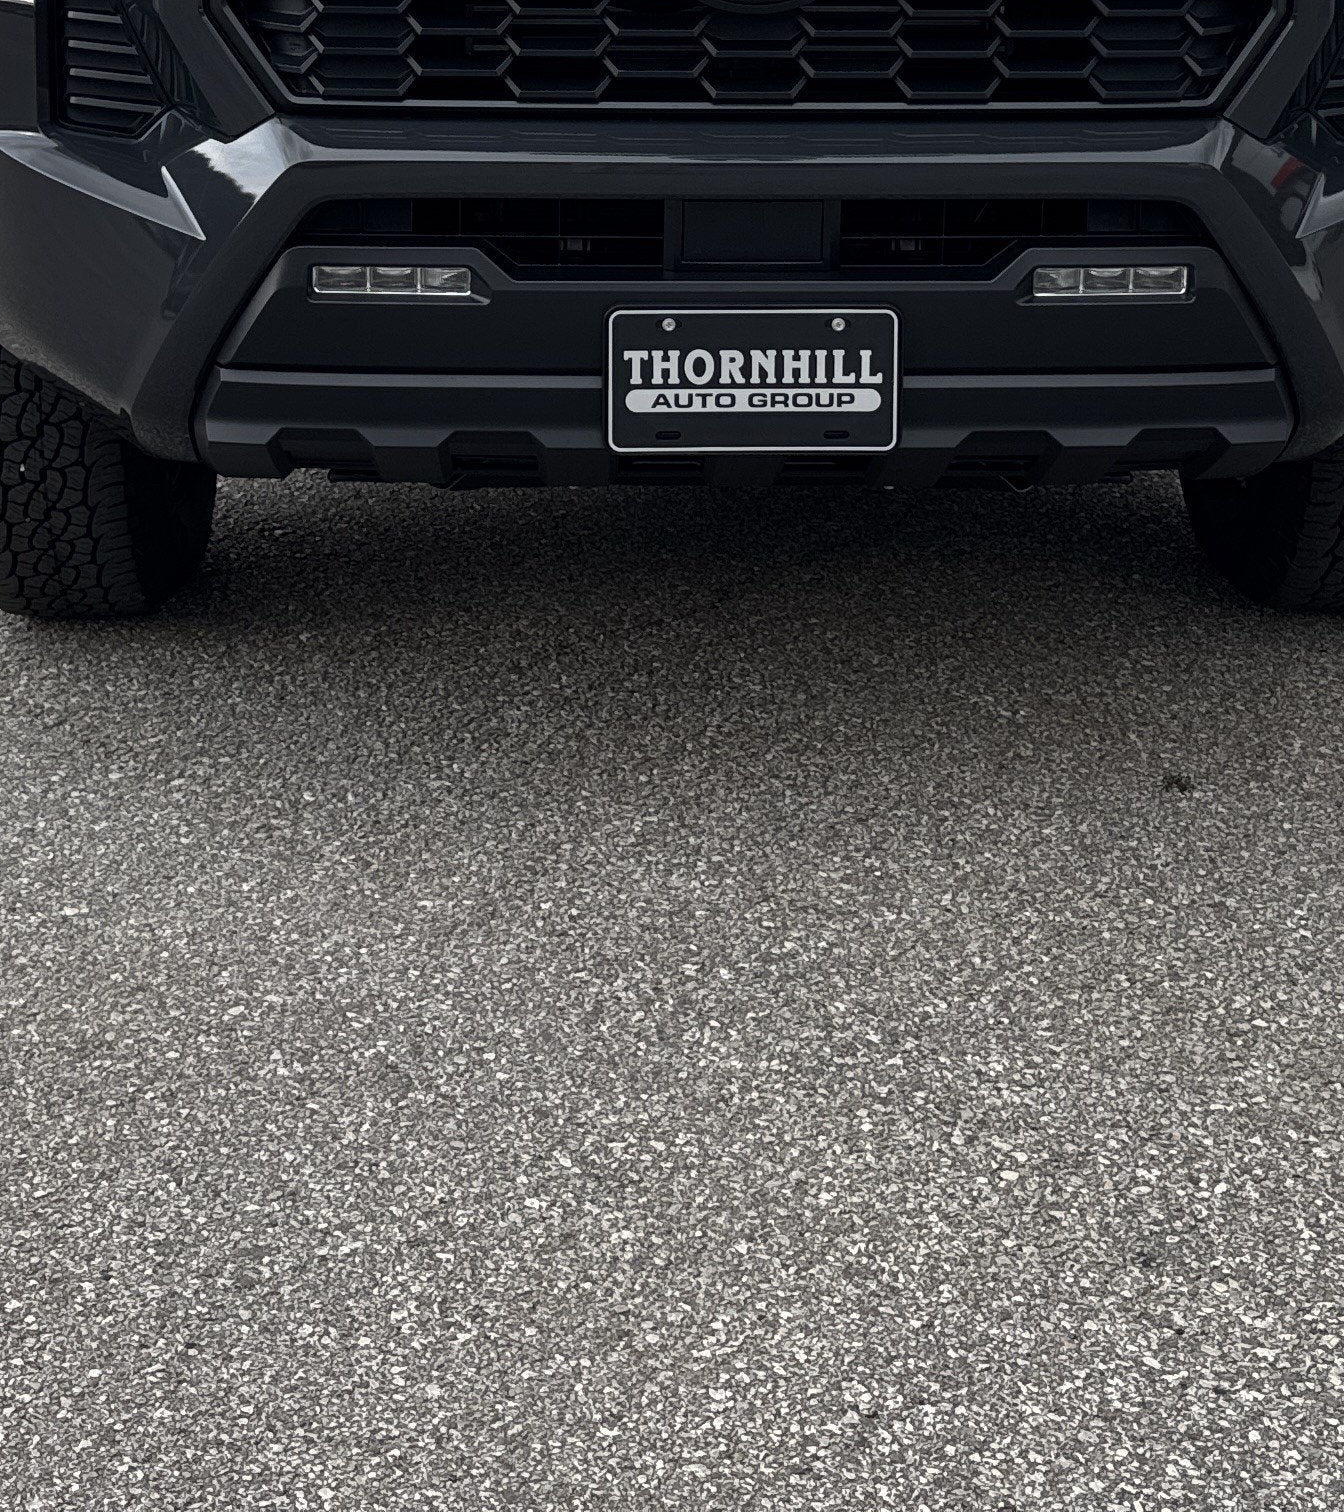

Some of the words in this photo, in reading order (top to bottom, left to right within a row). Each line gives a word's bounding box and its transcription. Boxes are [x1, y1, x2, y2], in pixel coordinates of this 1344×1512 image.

[623, 348, 883, 385] THORNHILL
[651, 392, 737, 409] AUTO
[747, 392, 856, 408] GROUP
